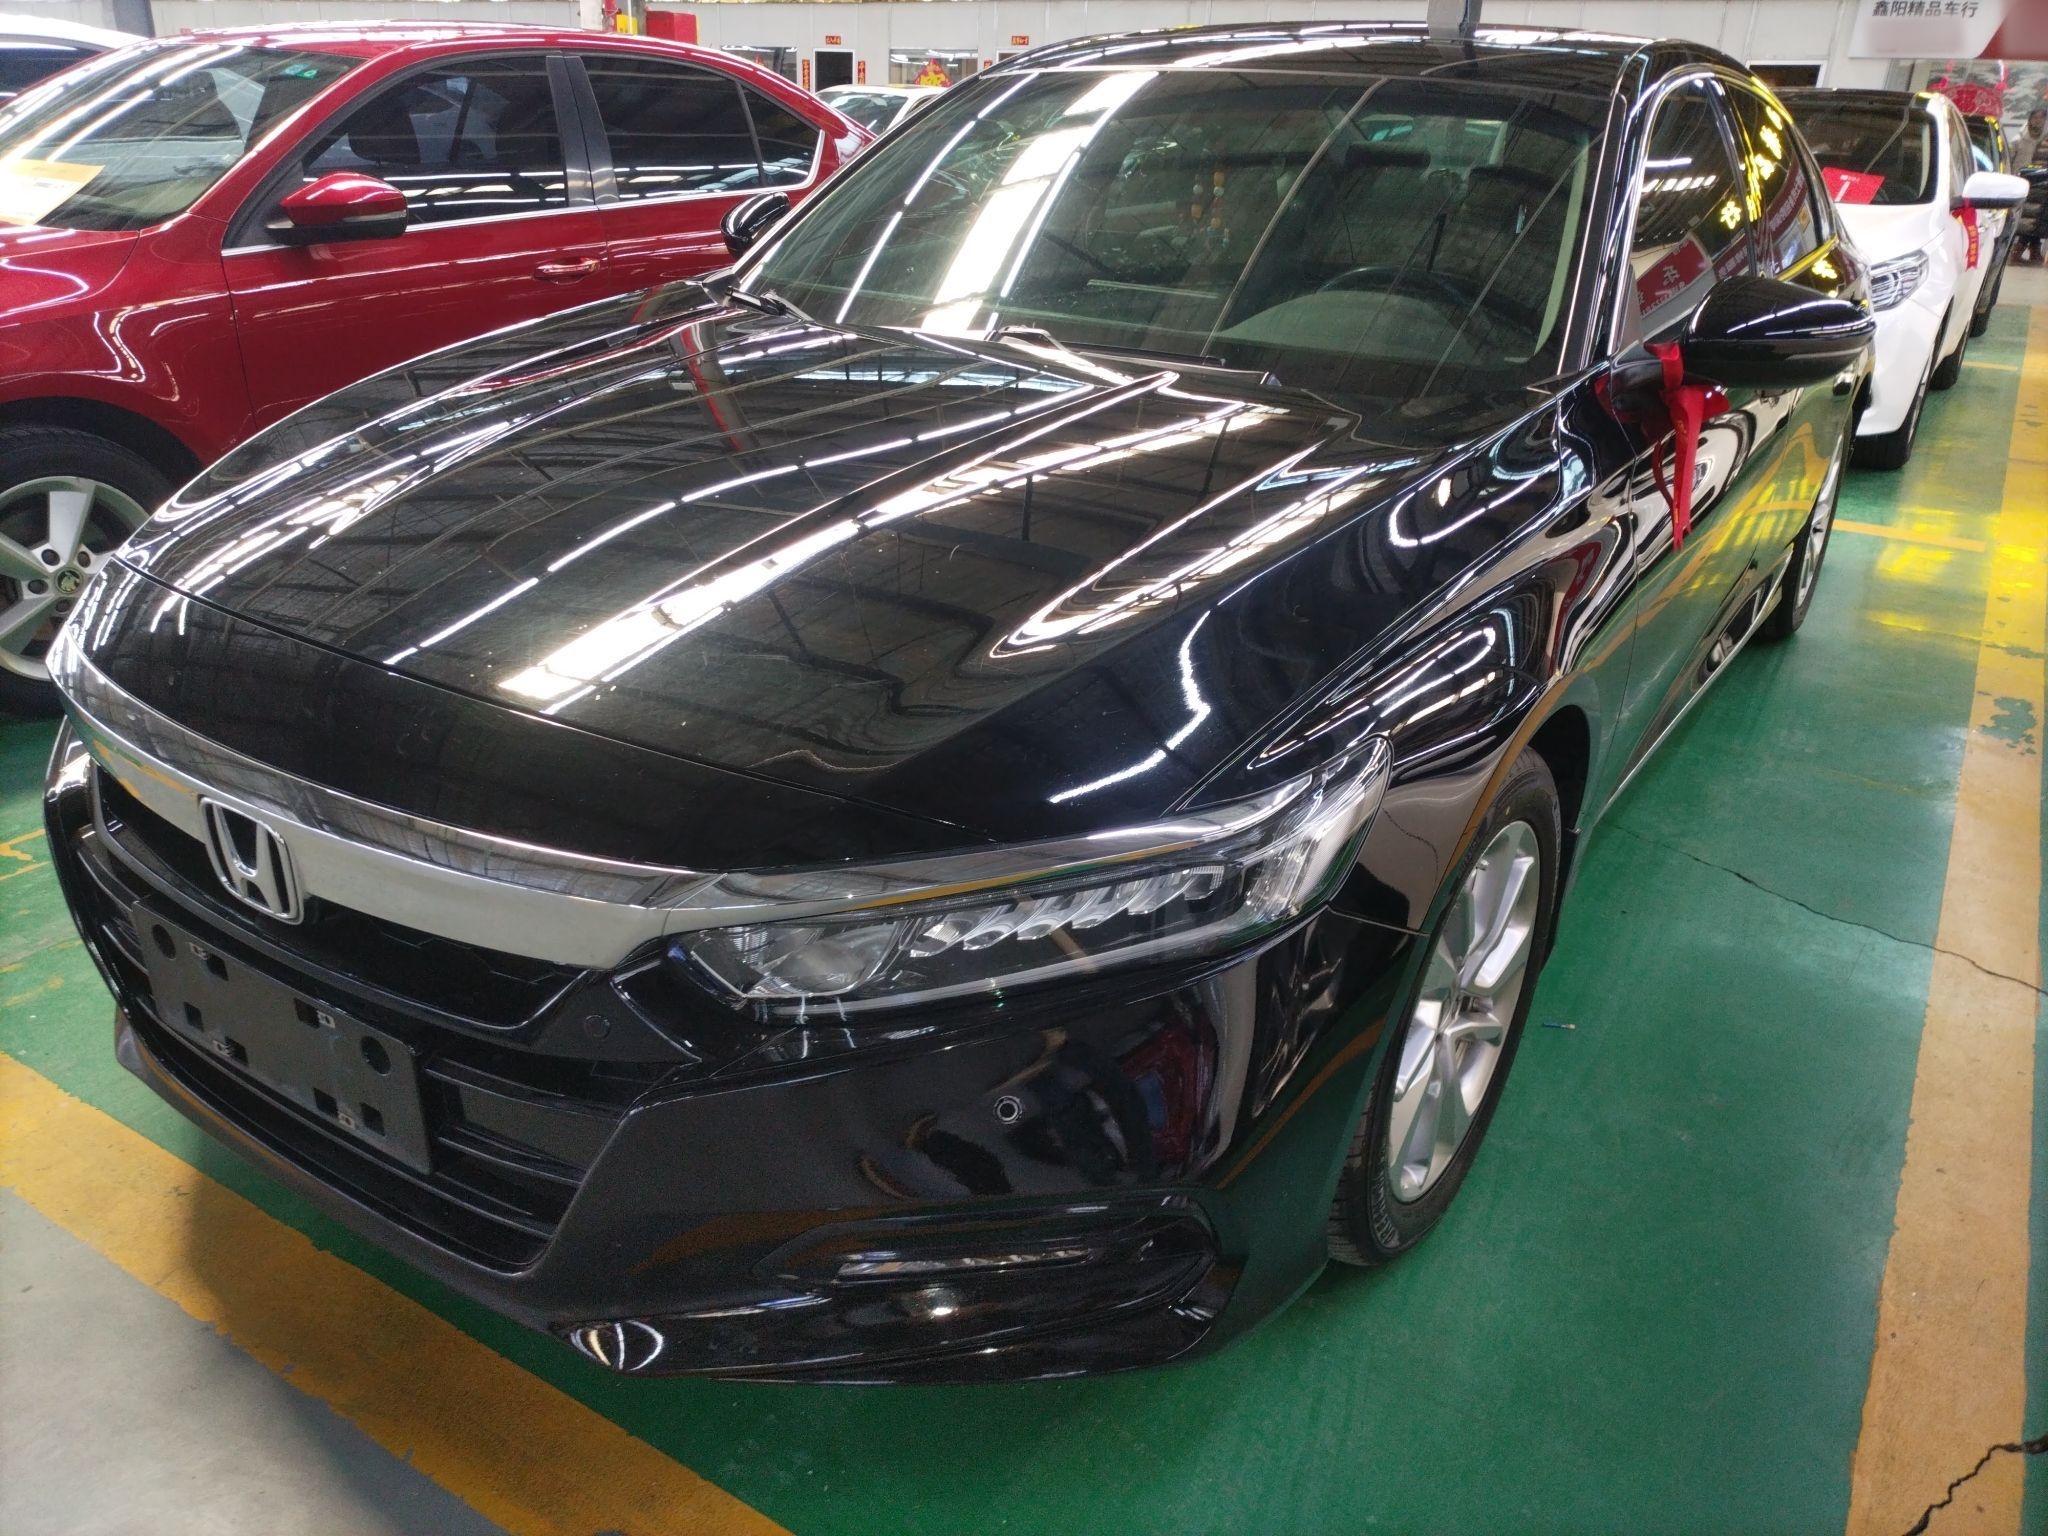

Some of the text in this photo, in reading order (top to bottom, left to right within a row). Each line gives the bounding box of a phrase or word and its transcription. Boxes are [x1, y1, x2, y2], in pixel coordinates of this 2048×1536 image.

[1872, 1, 1979, 18] 鑫阳精品车行
